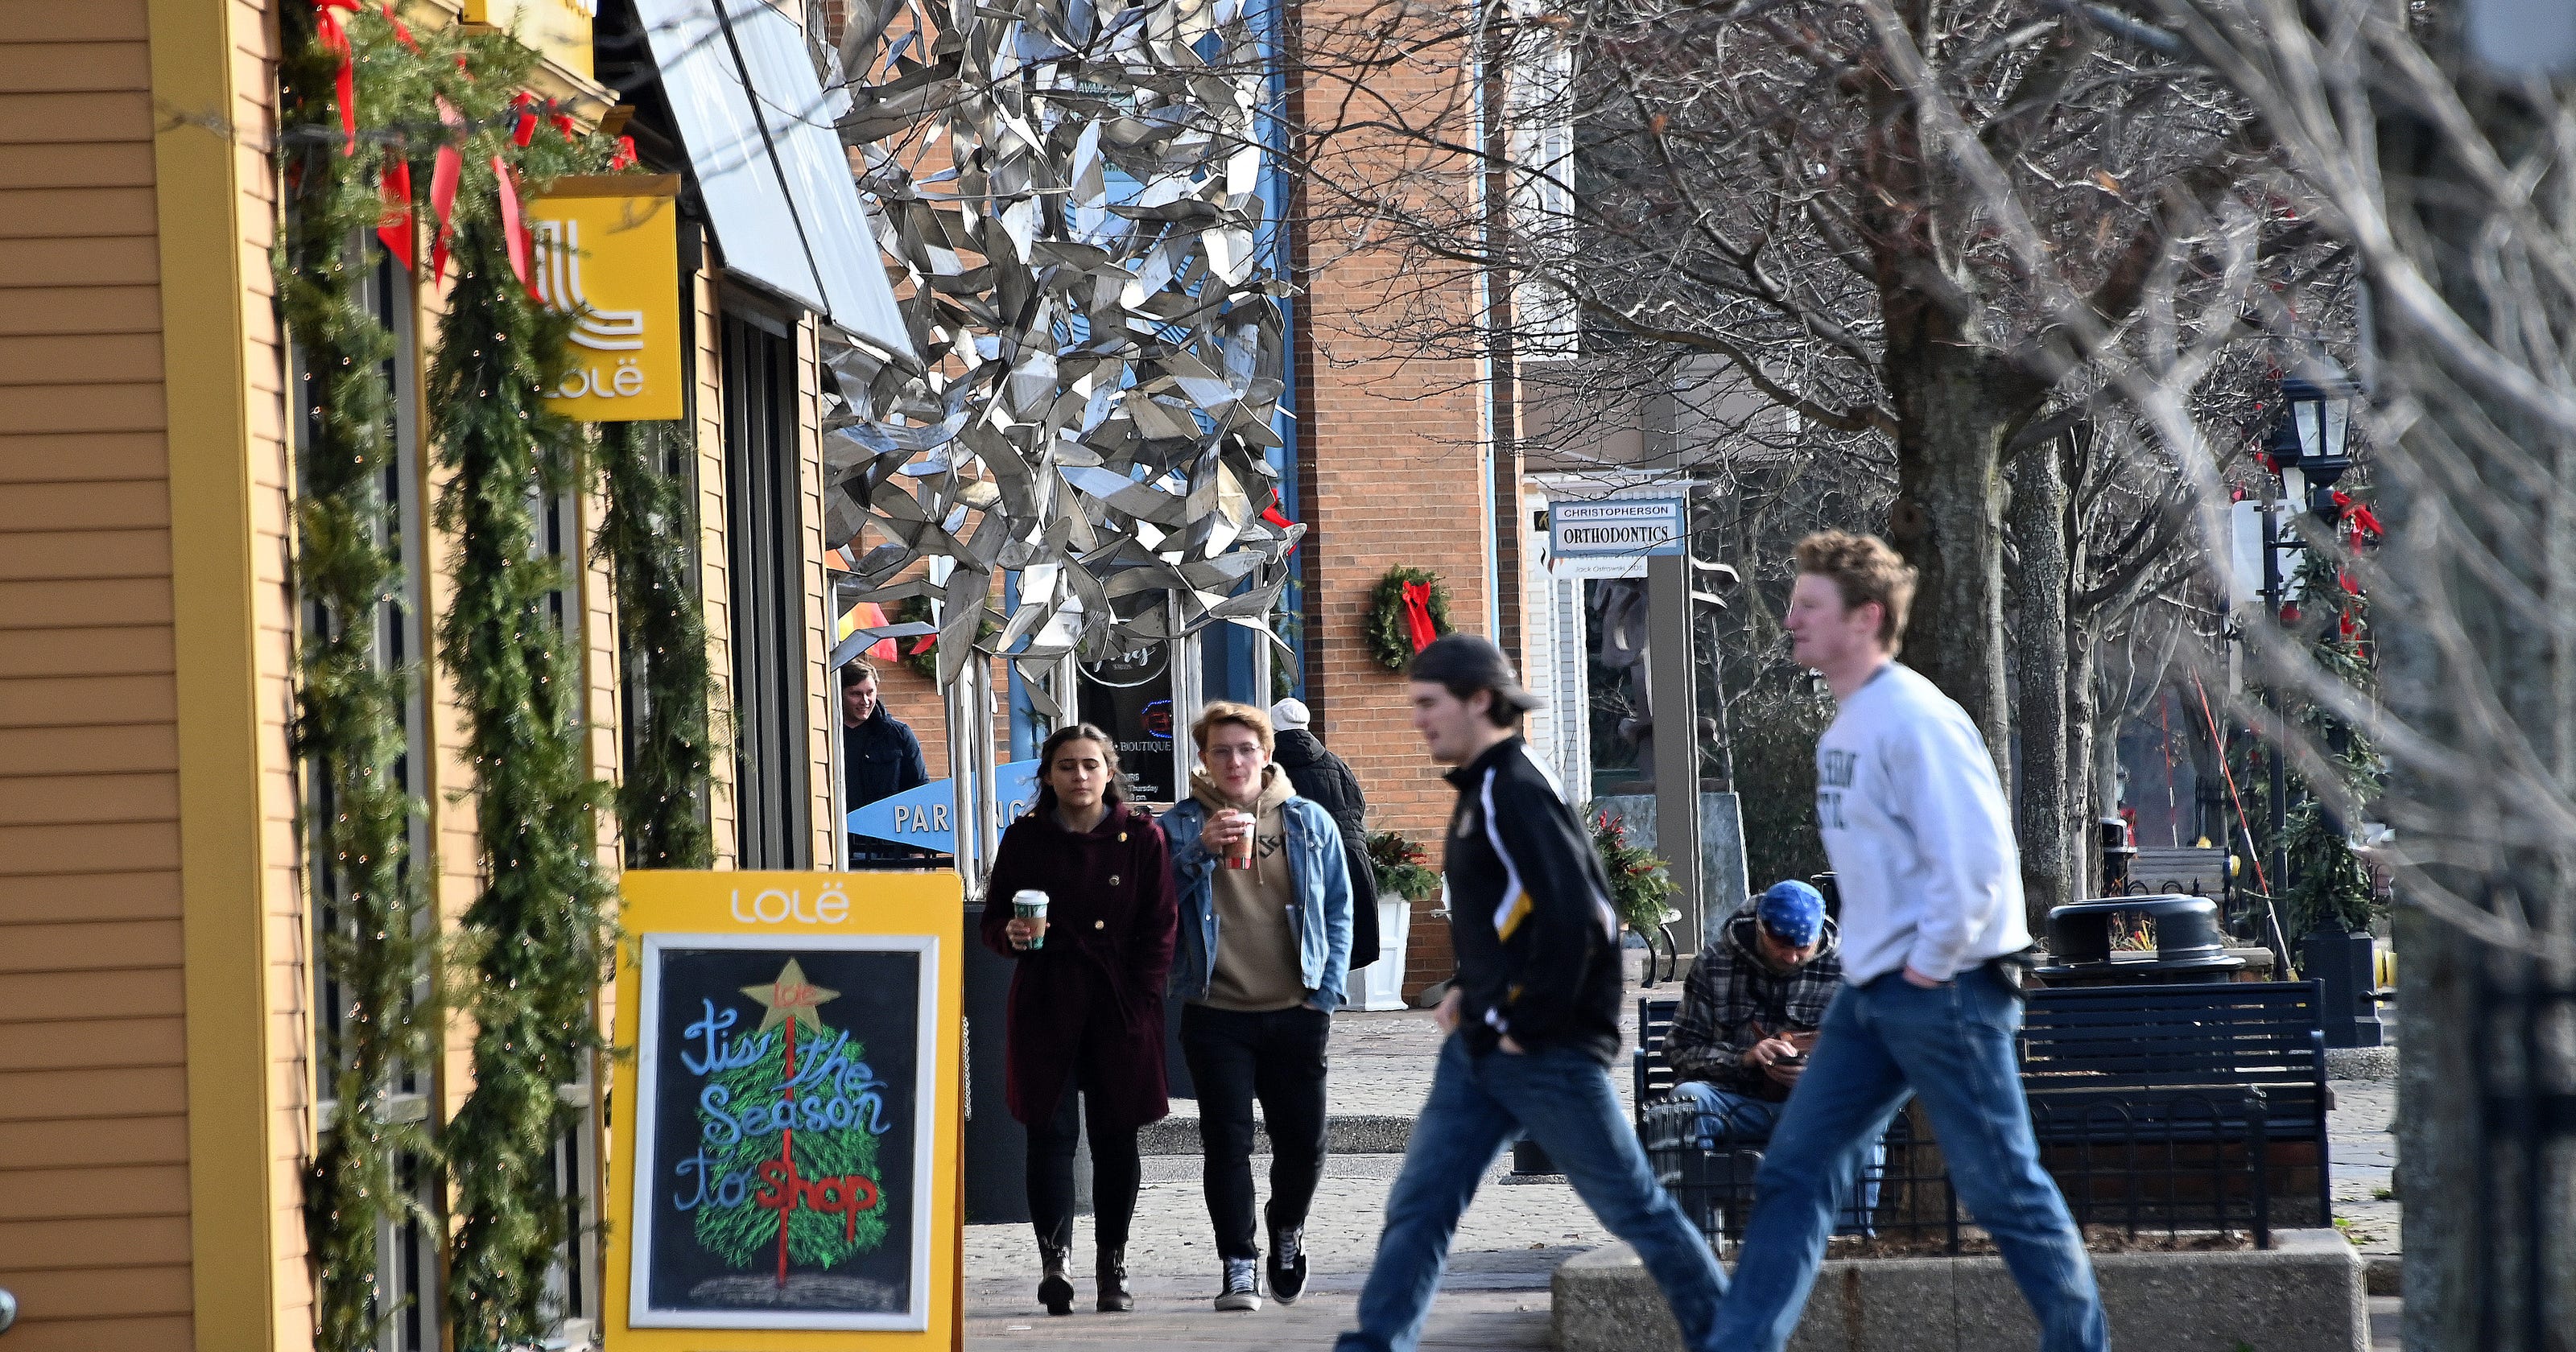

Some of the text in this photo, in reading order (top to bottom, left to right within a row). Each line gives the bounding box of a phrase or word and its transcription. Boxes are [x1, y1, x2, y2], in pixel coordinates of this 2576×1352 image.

[1563, 505, 1669, 517] CHRISTOPHERSON
[1563, 526, 1669, 544] ORTHODONTICS
[1120, 741, 1172, 752] BOUTIQUE
[1128, 785, 1158, 793] Thursday
[894, 799, 1026, 834] PARNG
[770, 1029, 888, 1097] the
[700, 1084, 891, 1144] Season
[674, 1145, 753, 1210] to
